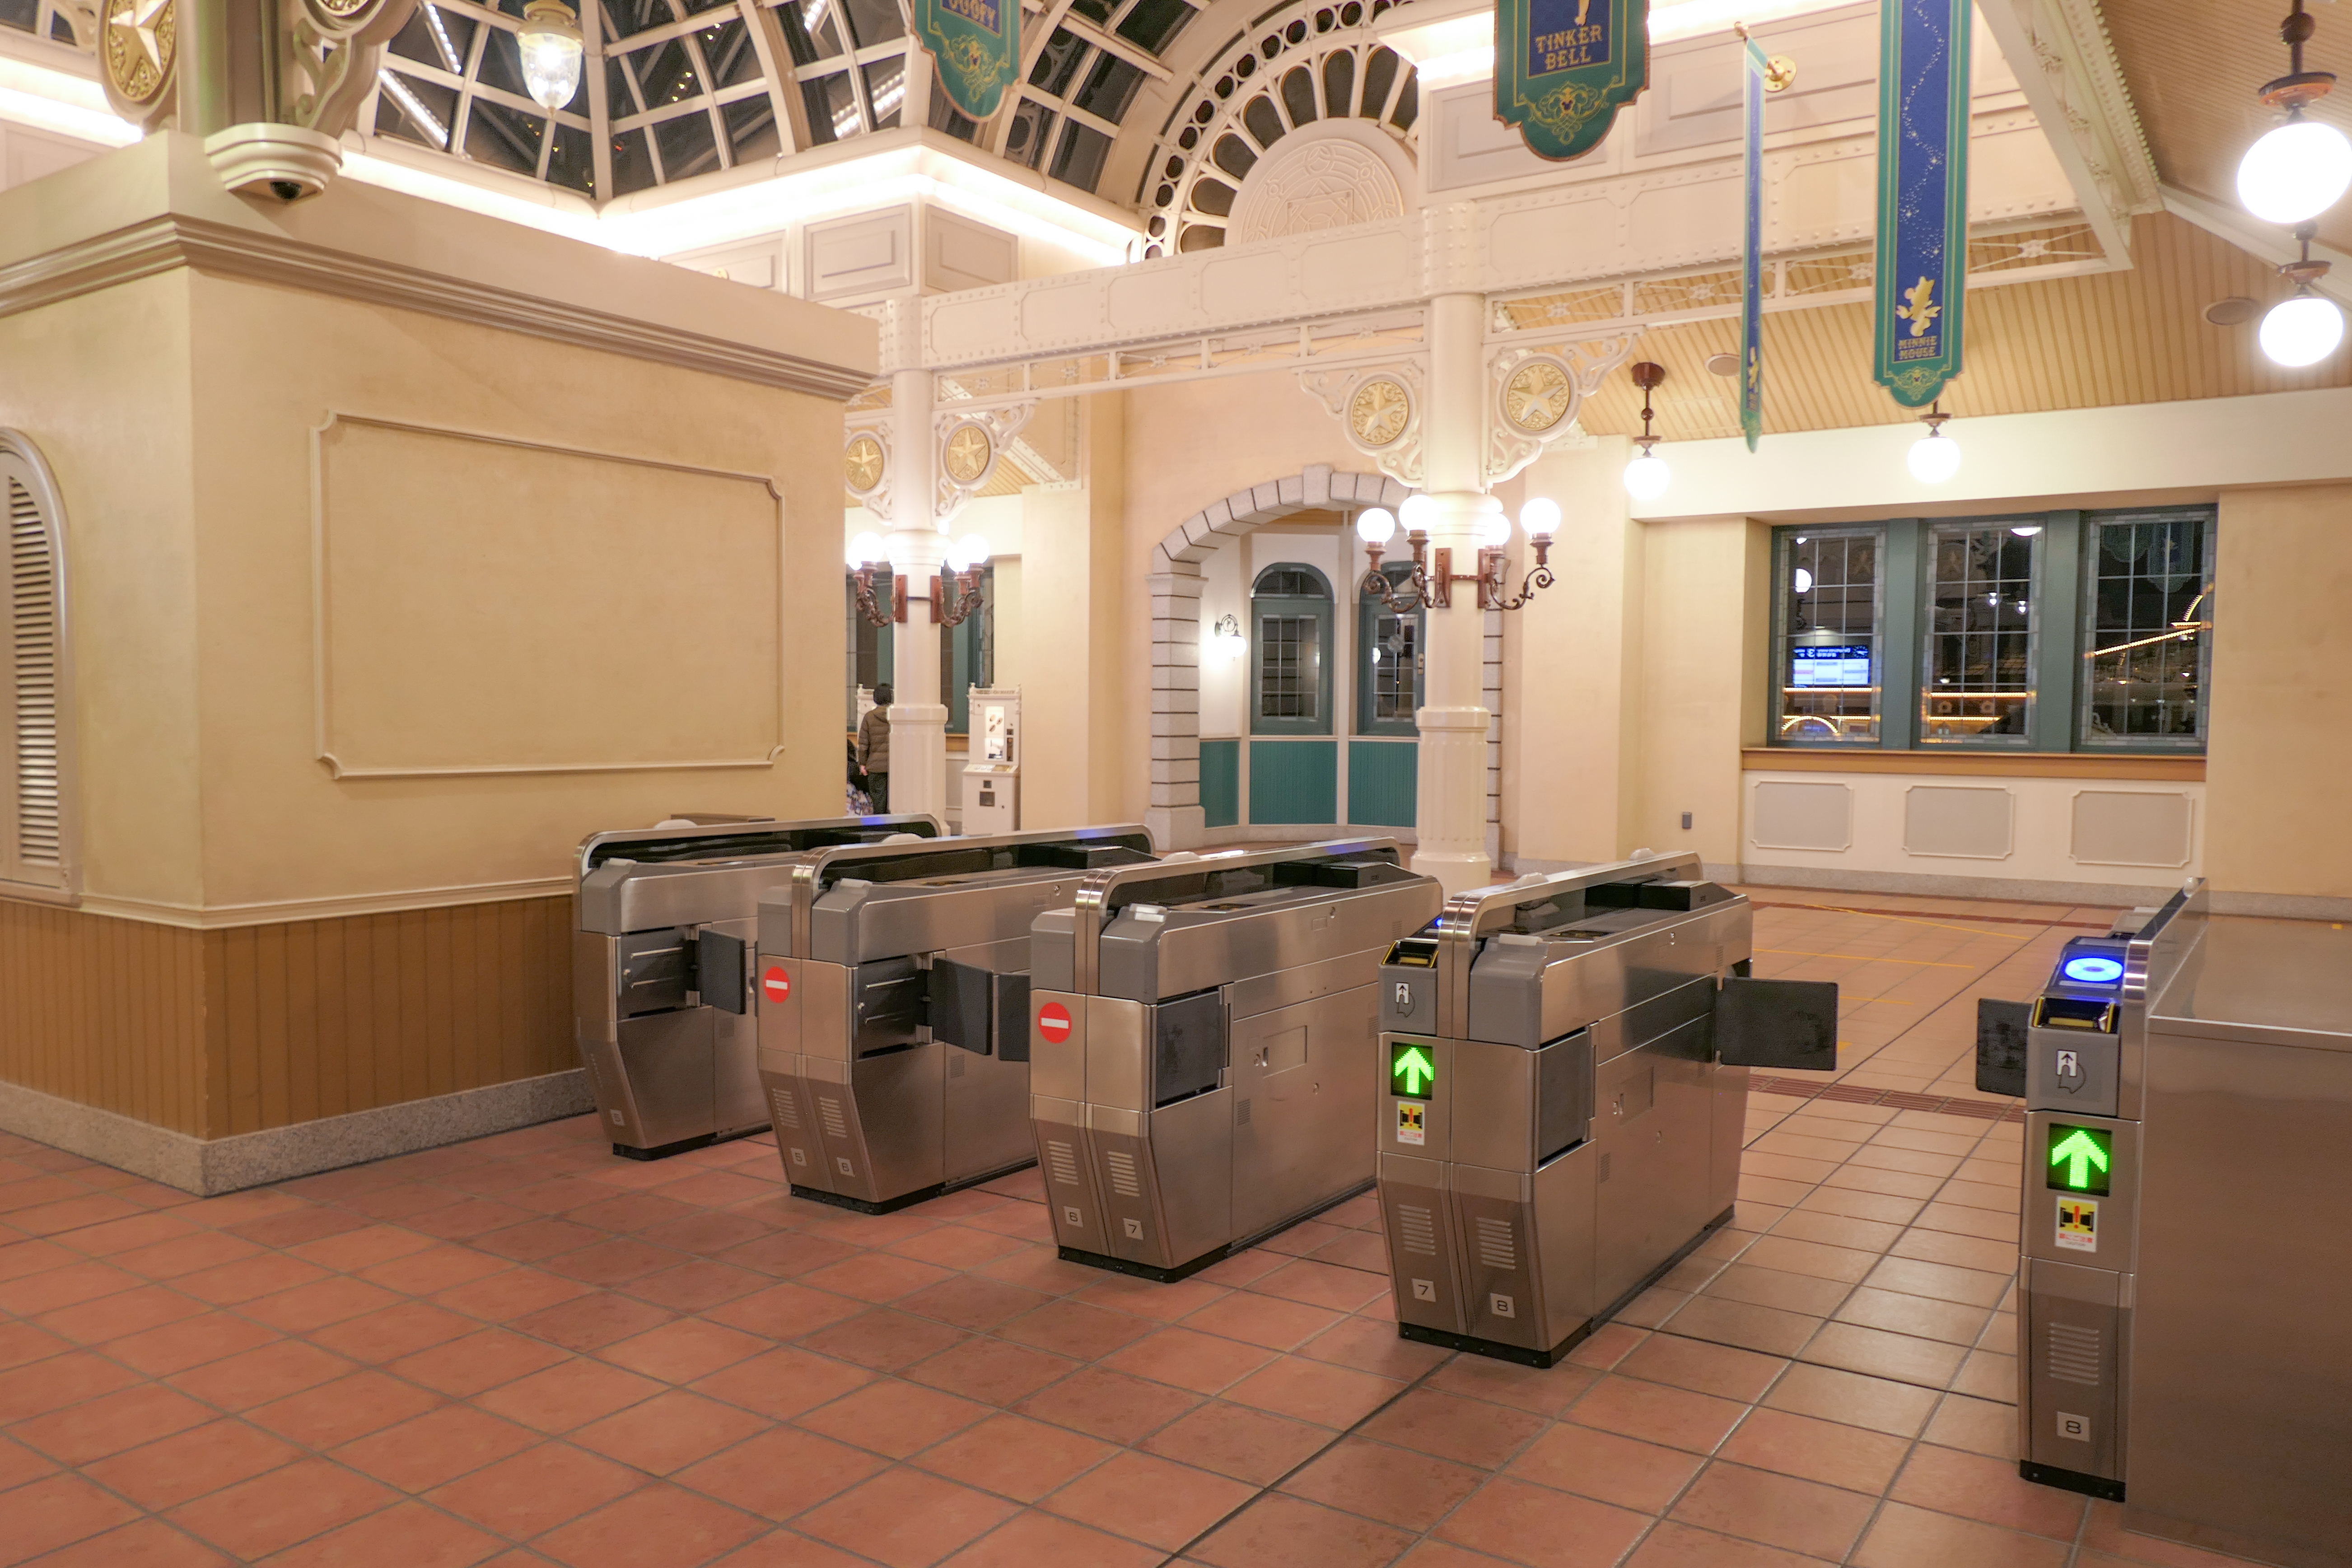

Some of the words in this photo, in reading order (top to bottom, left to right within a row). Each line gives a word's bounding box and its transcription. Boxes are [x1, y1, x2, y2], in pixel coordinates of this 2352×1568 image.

[1535, 24, 1603, 53] TINKER
[1545, 46, 1591, 70] BELL
[1898, 335, 1937, 350] MINNIE
[1899, 346, 1936, 360] MOUSE
[795, 1153, 803, 1162] 5
[1128, 1223, 1137, 1234] 7
[1418, 1284, 1429, 1296] 7
[1497, 1300, 1508, 1312] 8
[2066, 1420, 2081, 1434] 8
